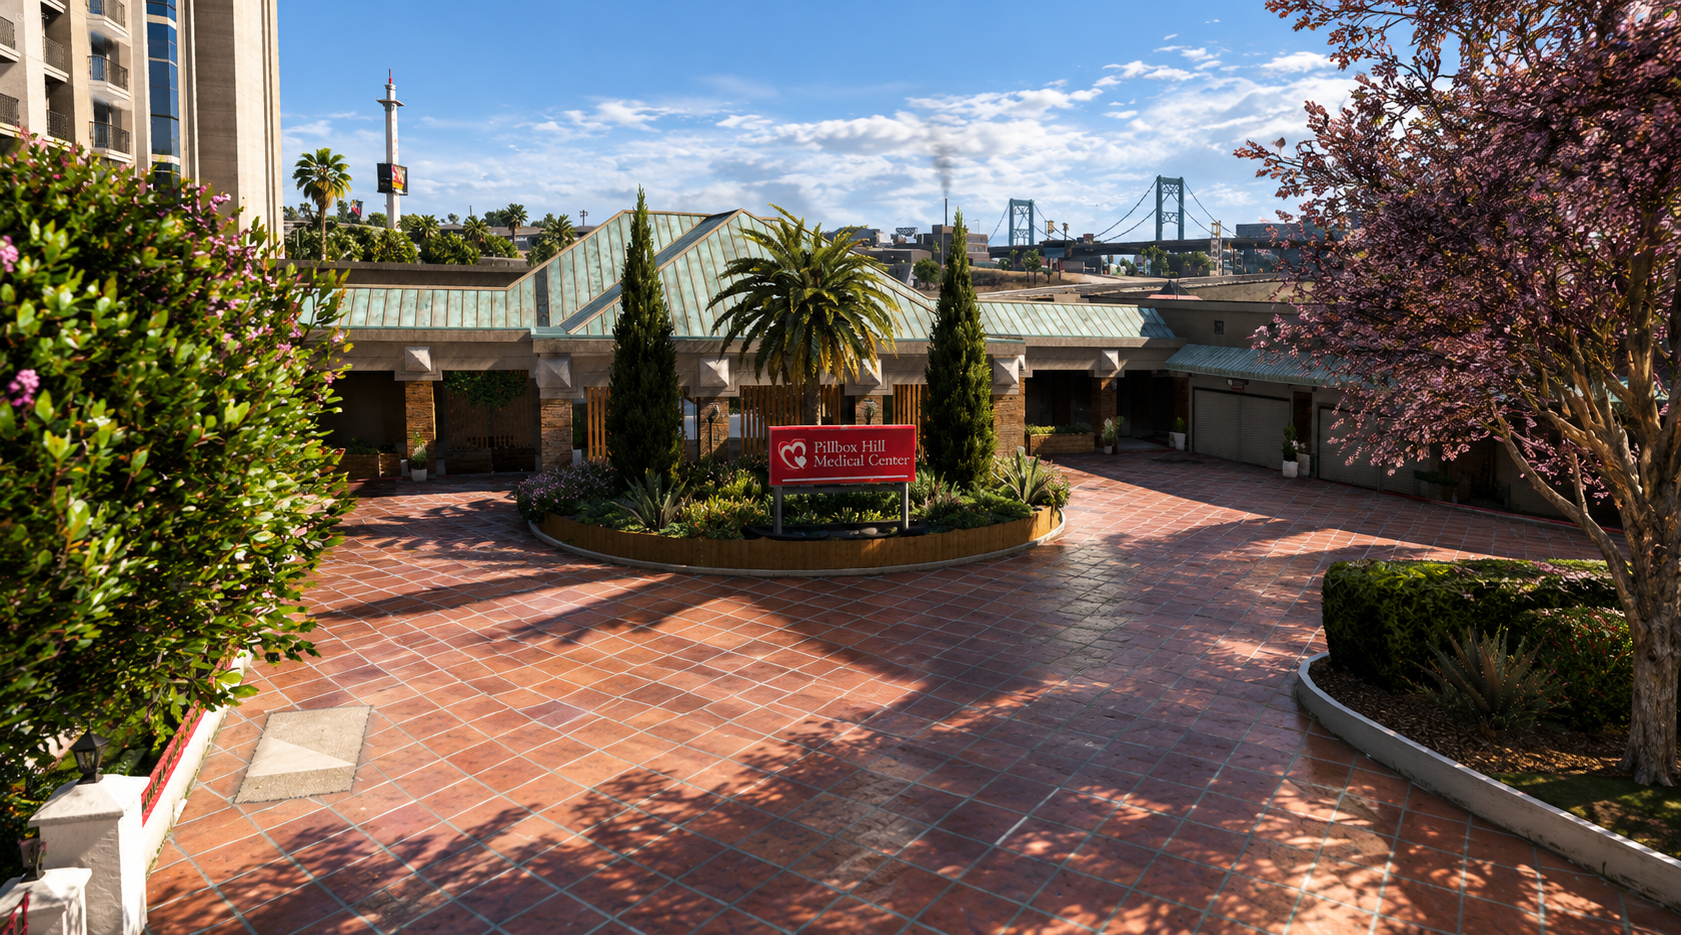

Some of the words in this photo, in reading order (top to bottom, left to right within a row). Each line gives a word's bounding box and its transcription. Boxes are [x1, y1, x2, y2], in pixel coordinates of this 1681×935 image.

[814, 440, 858, 453] Pillbox
[862, 440, 885, 452] Hill
[814, 454, 864, 467] Medical
[868, 454, 910, 466] Center
